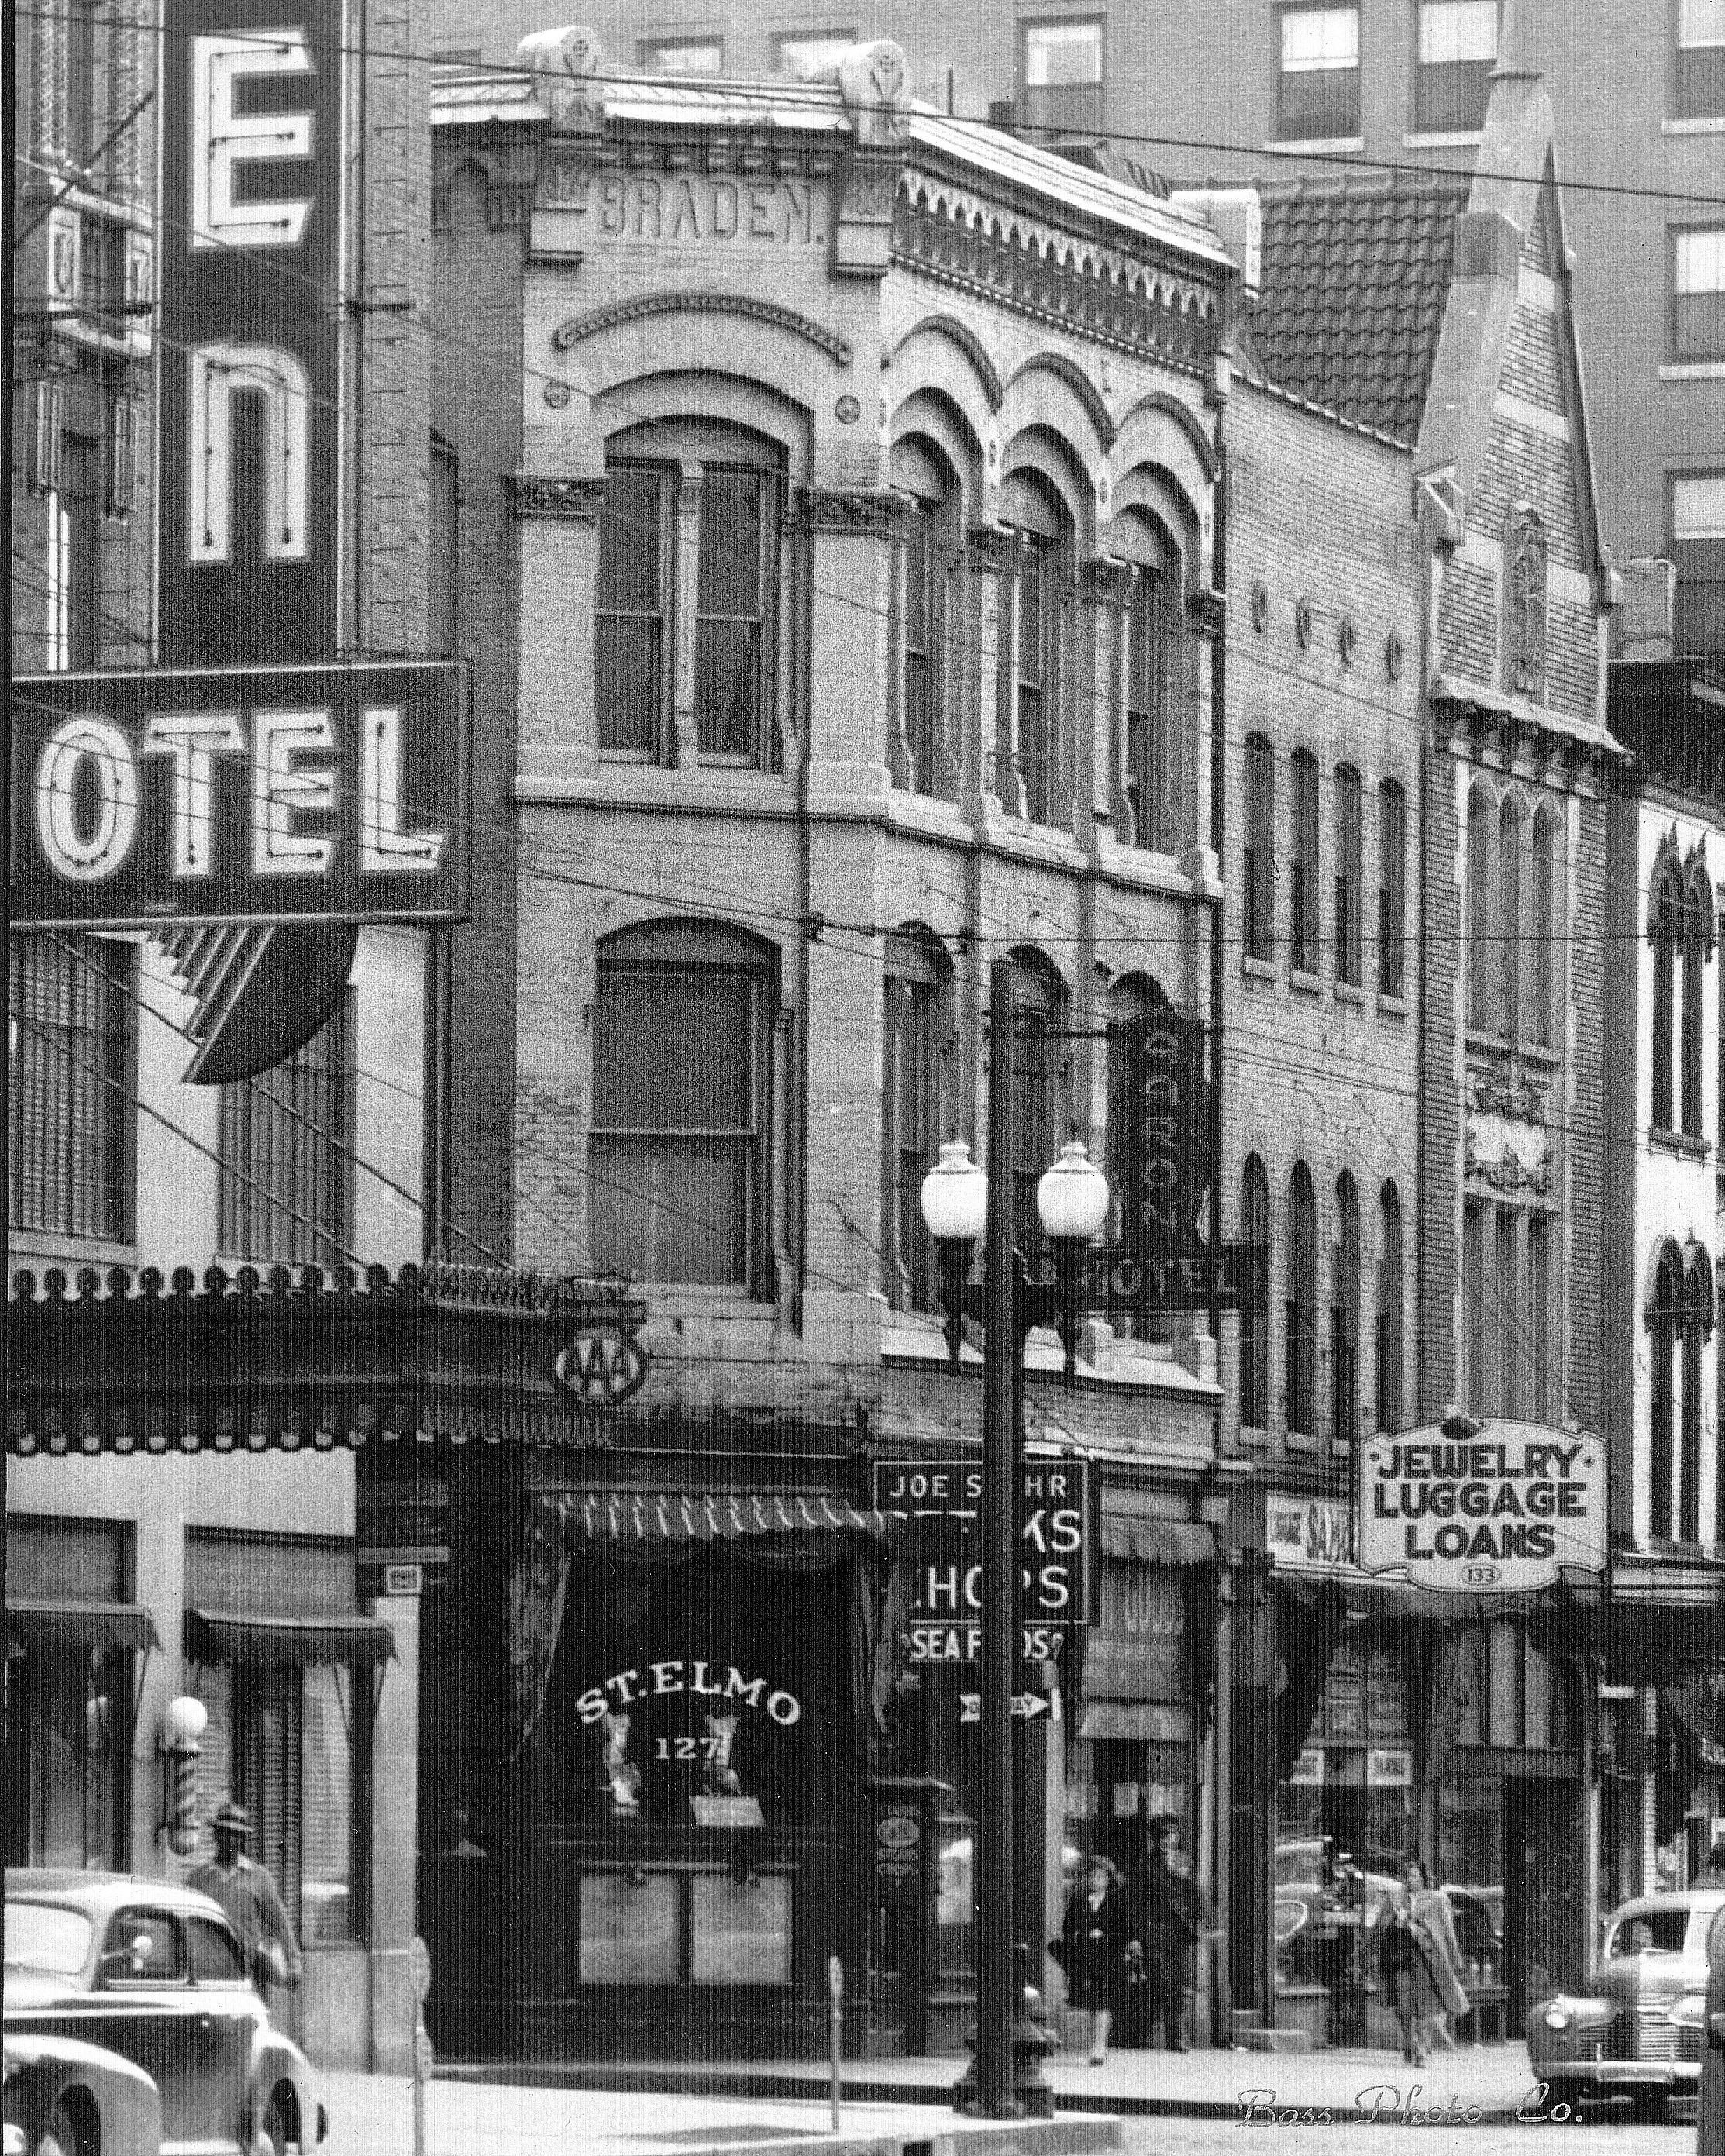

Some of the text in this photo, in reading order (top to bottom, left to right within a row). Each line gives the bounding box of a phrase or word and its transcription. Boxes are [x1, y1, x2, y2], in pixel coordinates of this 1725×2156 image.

[1378, 1443, 1583, 1480] JEWELRY
[890, 1475, 1068, 1498] JOE SHR
[1373, 1481, 1586, 1518] LUGGAGE
[1404, 1523, 1557, 1560] LOANS
[1467, 1568, 1496, 1583] 133
[911, 1629, 961, 1659] SEA
[655, 1736, 724, 1761] 127
